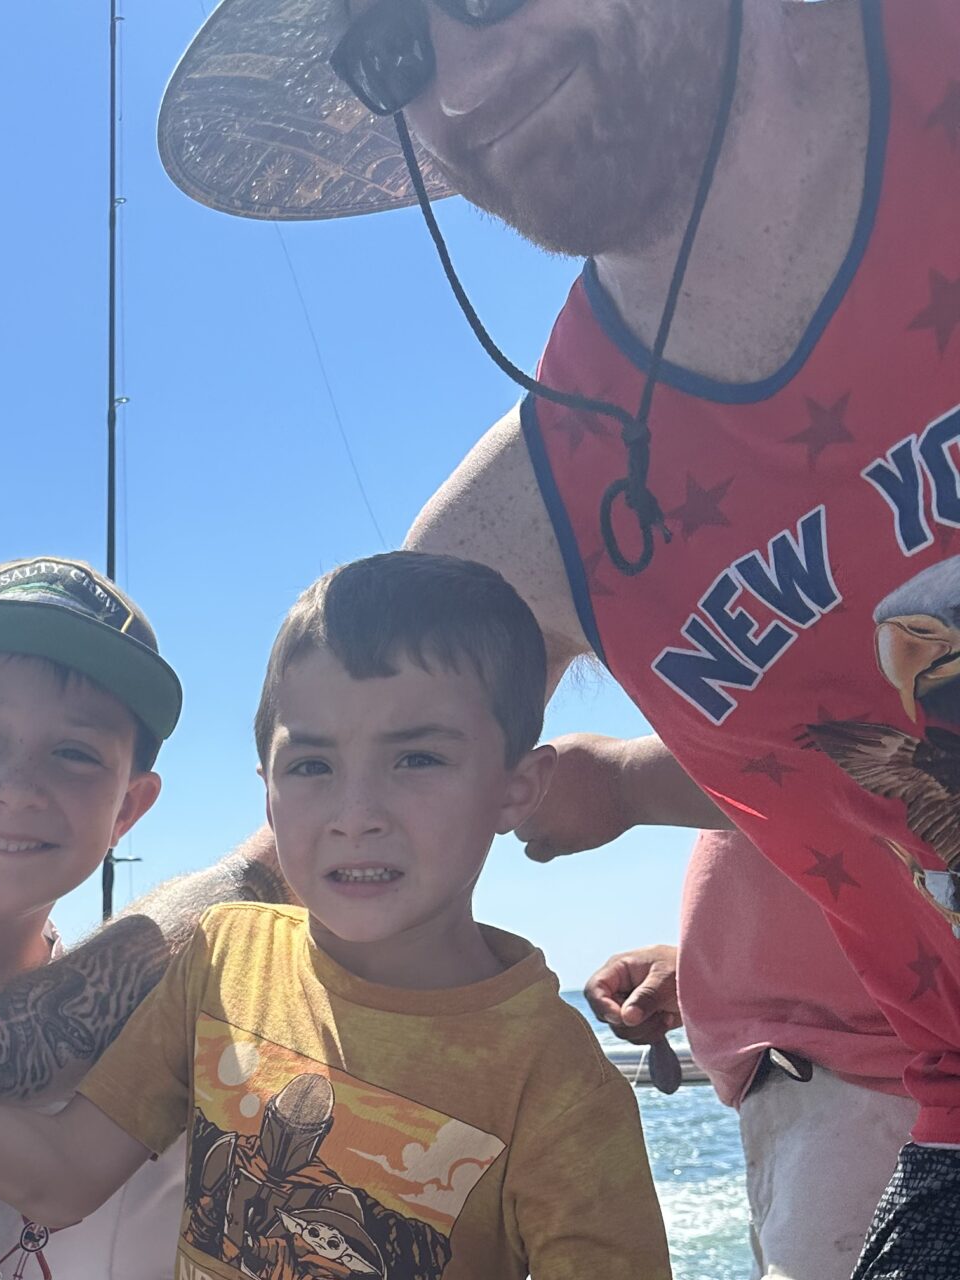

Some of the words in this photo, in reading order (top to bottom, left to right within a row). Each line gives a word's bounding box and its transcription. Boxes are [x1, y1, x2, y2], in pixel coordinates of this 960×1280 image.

[0, 561, 65, 586] SALTY
[69, 569, 120, 613] CREW
[650, 503, 842, 726] NEW
[860, 403, 960, 557] YO
